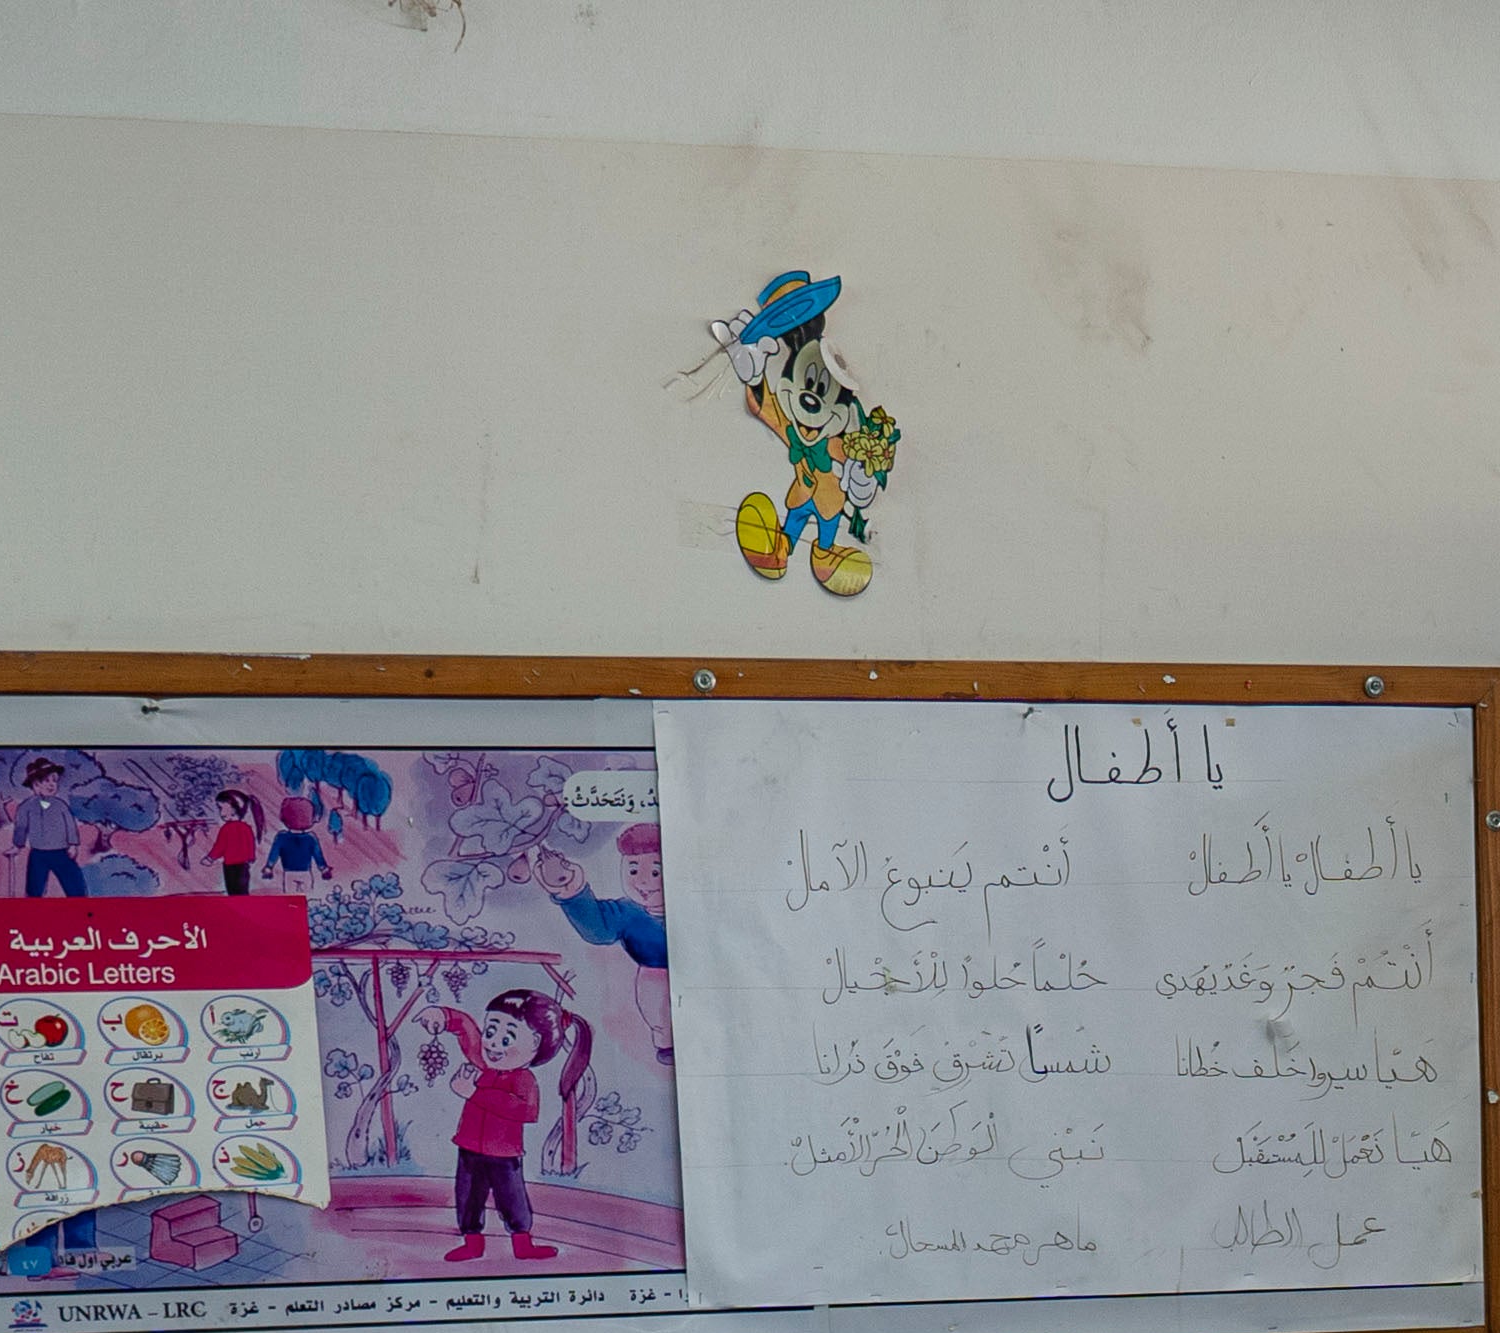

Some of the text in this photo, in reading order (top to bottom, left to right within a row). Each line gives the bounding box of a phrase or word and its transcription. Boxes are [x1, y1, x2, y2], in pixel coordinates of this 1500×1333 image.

[1204, 725, 1223, 789] يا
[1278, 832, 1291, 887] يا
[1405, 826, 1421, 883] يا
[9, 925, 207, 957] الأحرف العربية
[88, 961, 176, 985] Letters
[101, 1013, 123, 1031] ب
[4, 1080, 24, 1105] خ
[110, 1082, 128, 1103] ح
[212, 1080, 230, 1100] ج
[13, 1152, 26, 1173] ز
[116, 1152, 129, 1167] ر
[219, 1146, 230, 1163] ذ
[1308, 1212, 1386, 1269] عمل
[386, 1297, 421, 1313] مركز
[445, 1293, 500, 1311] والتعليم
[509, 1290, 560, 1307] التربية
[568, 1290, 605, 1304] دائرة
[629, 1289, 657, 1304] غزة
[58, 1304, 142, 1322] UNRWA
[163, 1302, 208, 1319] LRC
[229, 1301, 260, 1318] غزة
[285, 1300, 325, 1316] التعلم
[333, 1297, 377, 1316] مصادر
